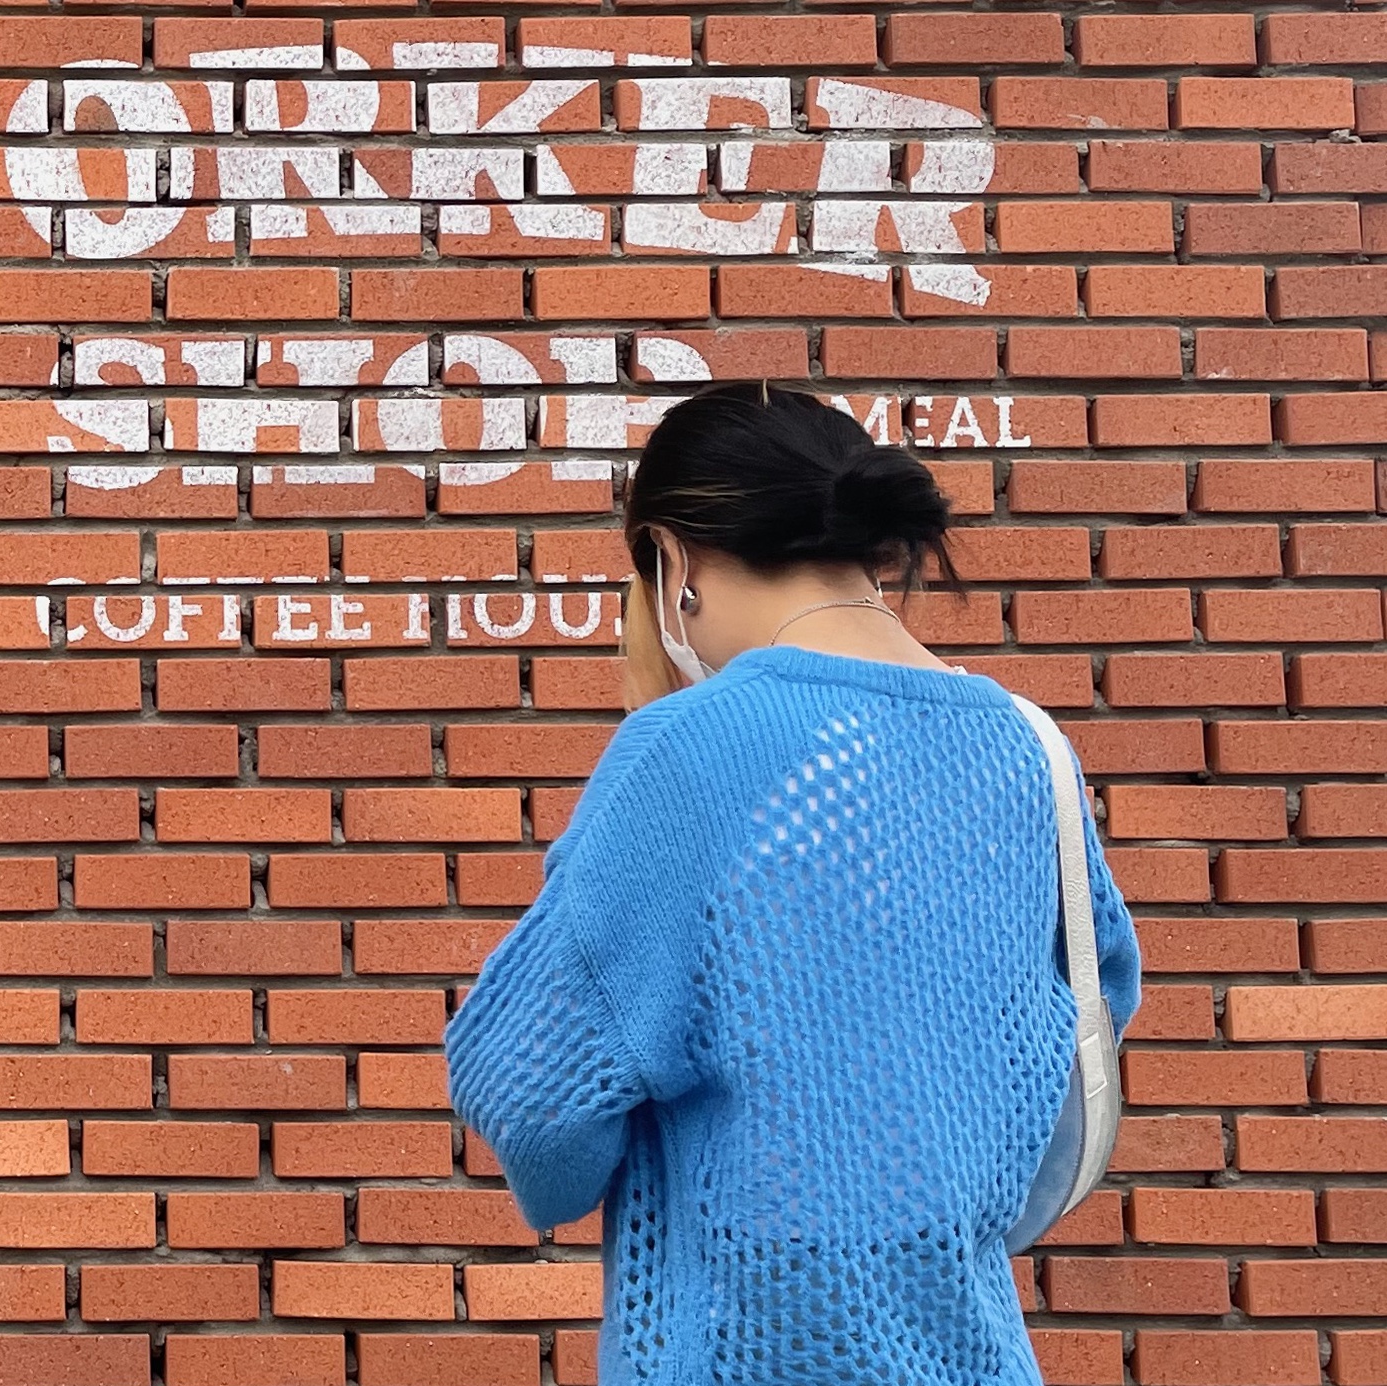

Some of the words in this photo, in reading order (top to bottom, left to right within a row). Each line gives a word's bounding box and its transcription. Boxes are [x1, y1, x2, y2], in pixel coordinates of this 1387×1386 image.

[47, 335, 712, 490] SHOP
[34, 576, 371, 642] COFFEE
[402, 573, 636, 641] HOU
